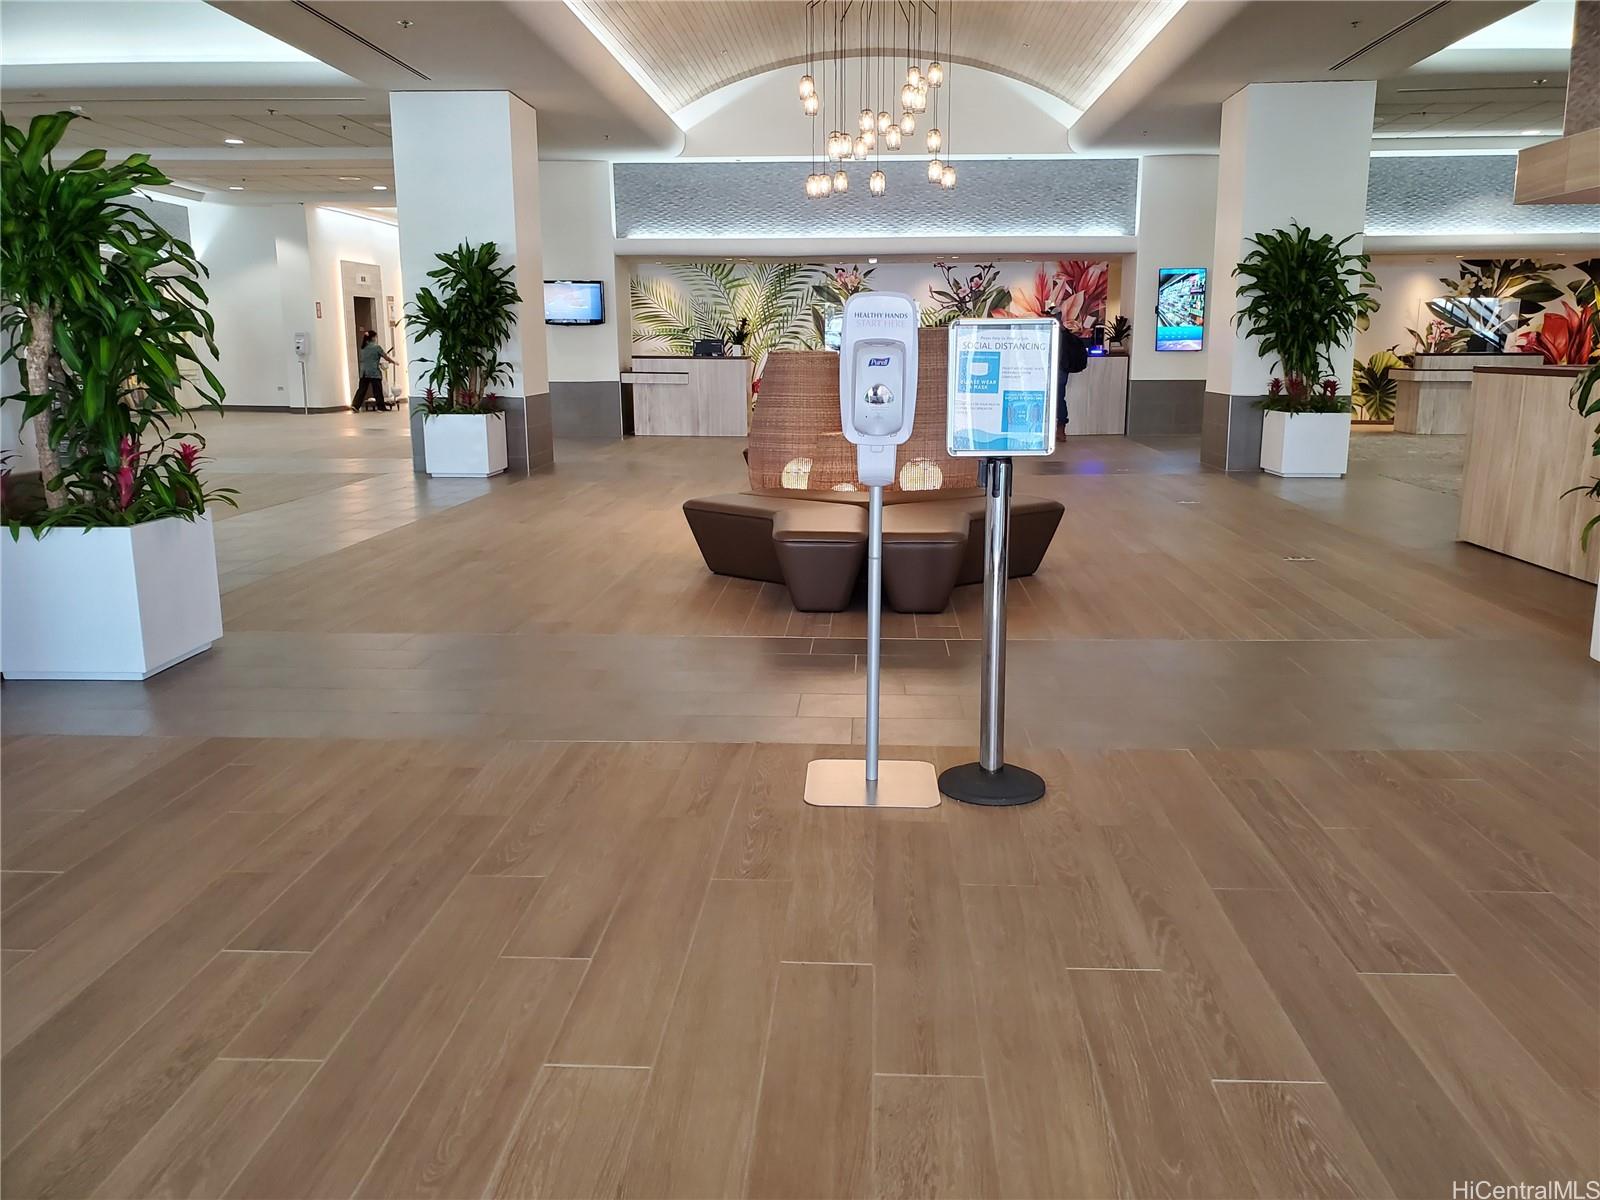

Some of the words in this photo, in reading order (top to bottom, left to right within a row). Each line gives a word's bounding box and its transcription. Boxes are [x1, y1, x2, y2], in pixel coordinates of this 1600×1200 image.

[856, 320, 880, 328] START
[884, 320, 905, 328] HERE
[962, 341, 992, 350] SOCIAL
[995, 342, 1046, 351] DISTANCING
